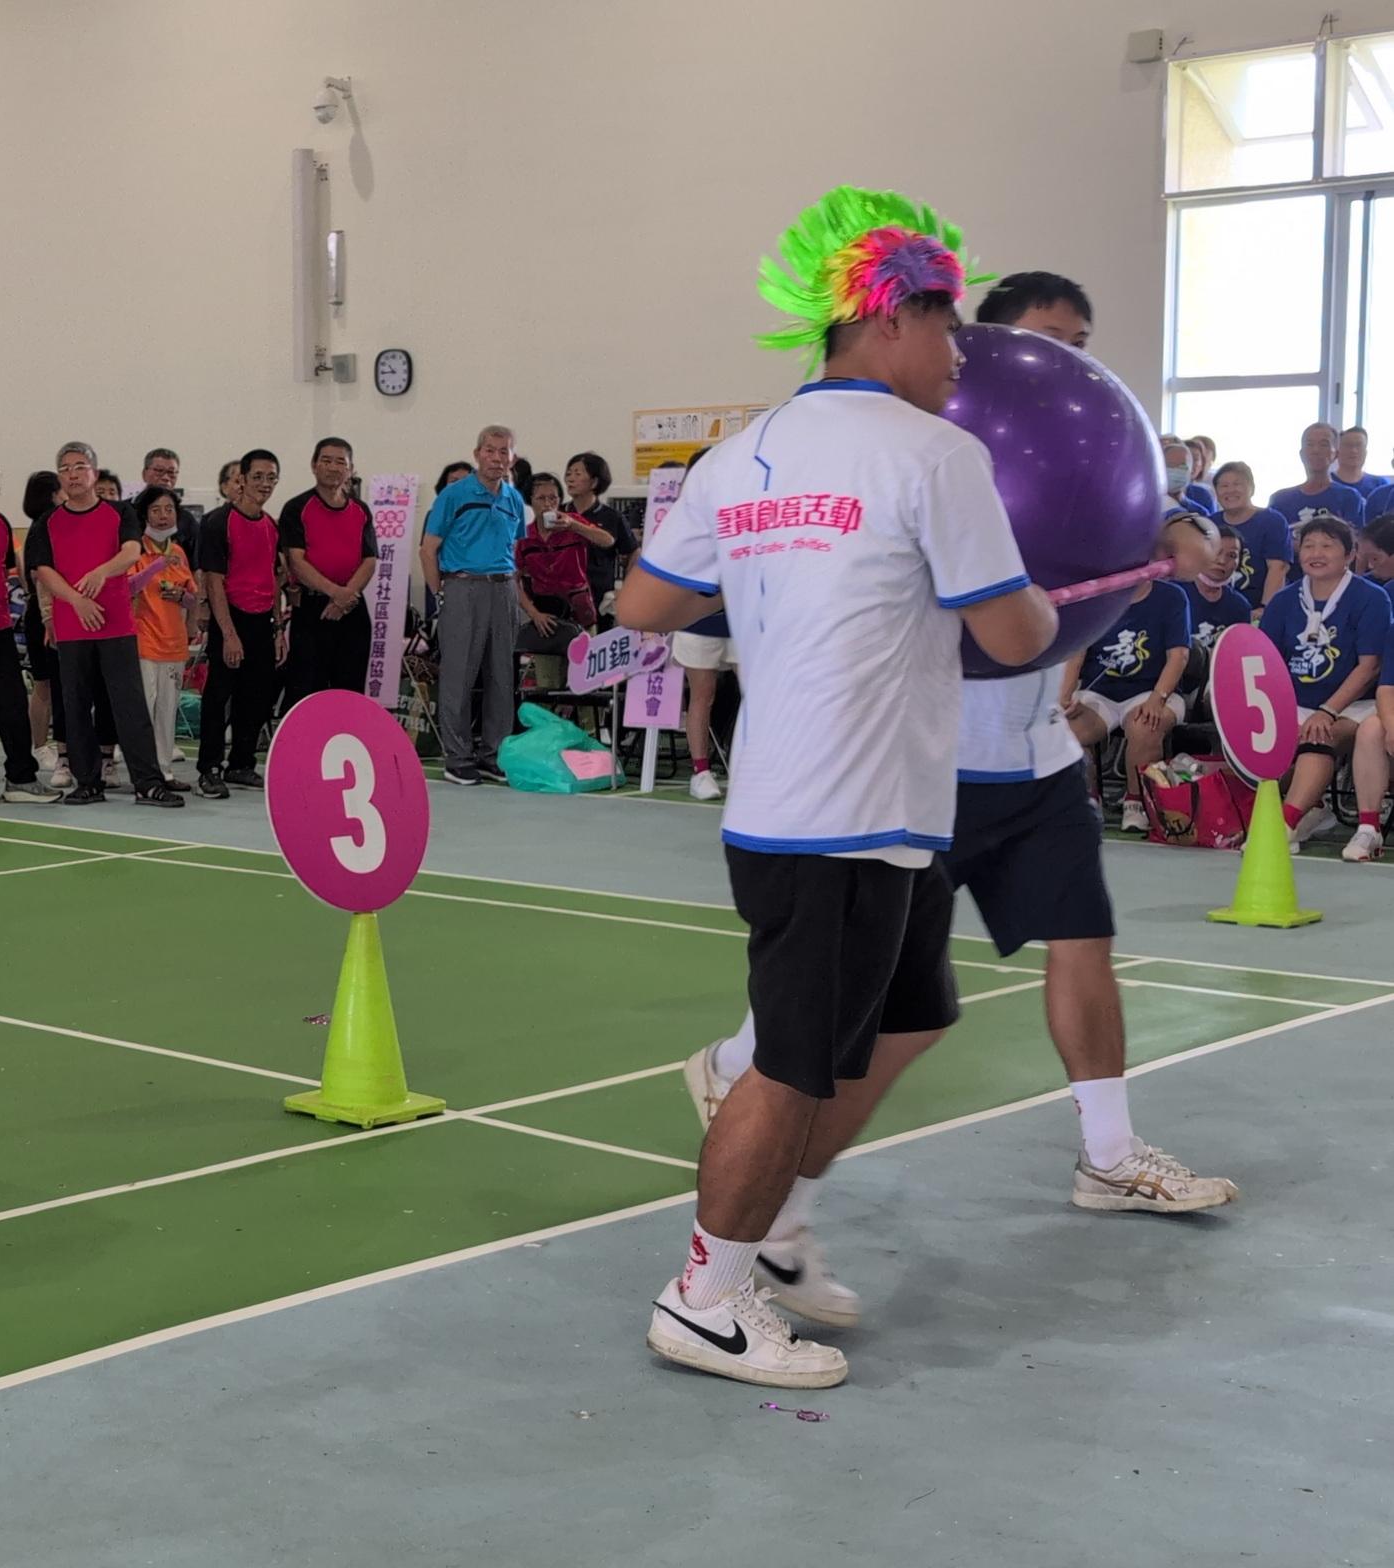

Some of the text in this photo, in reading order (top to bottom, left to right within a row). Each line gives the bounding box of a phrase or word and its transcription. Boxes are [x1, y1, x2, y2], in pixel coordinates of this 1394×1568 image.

[368, 544, 395, 698] 新興社區發展協會
[586, 635, 631, 680] 加錫
[1241, 655, 1277, 754] 5
[321, 733, 386, 874] 3
